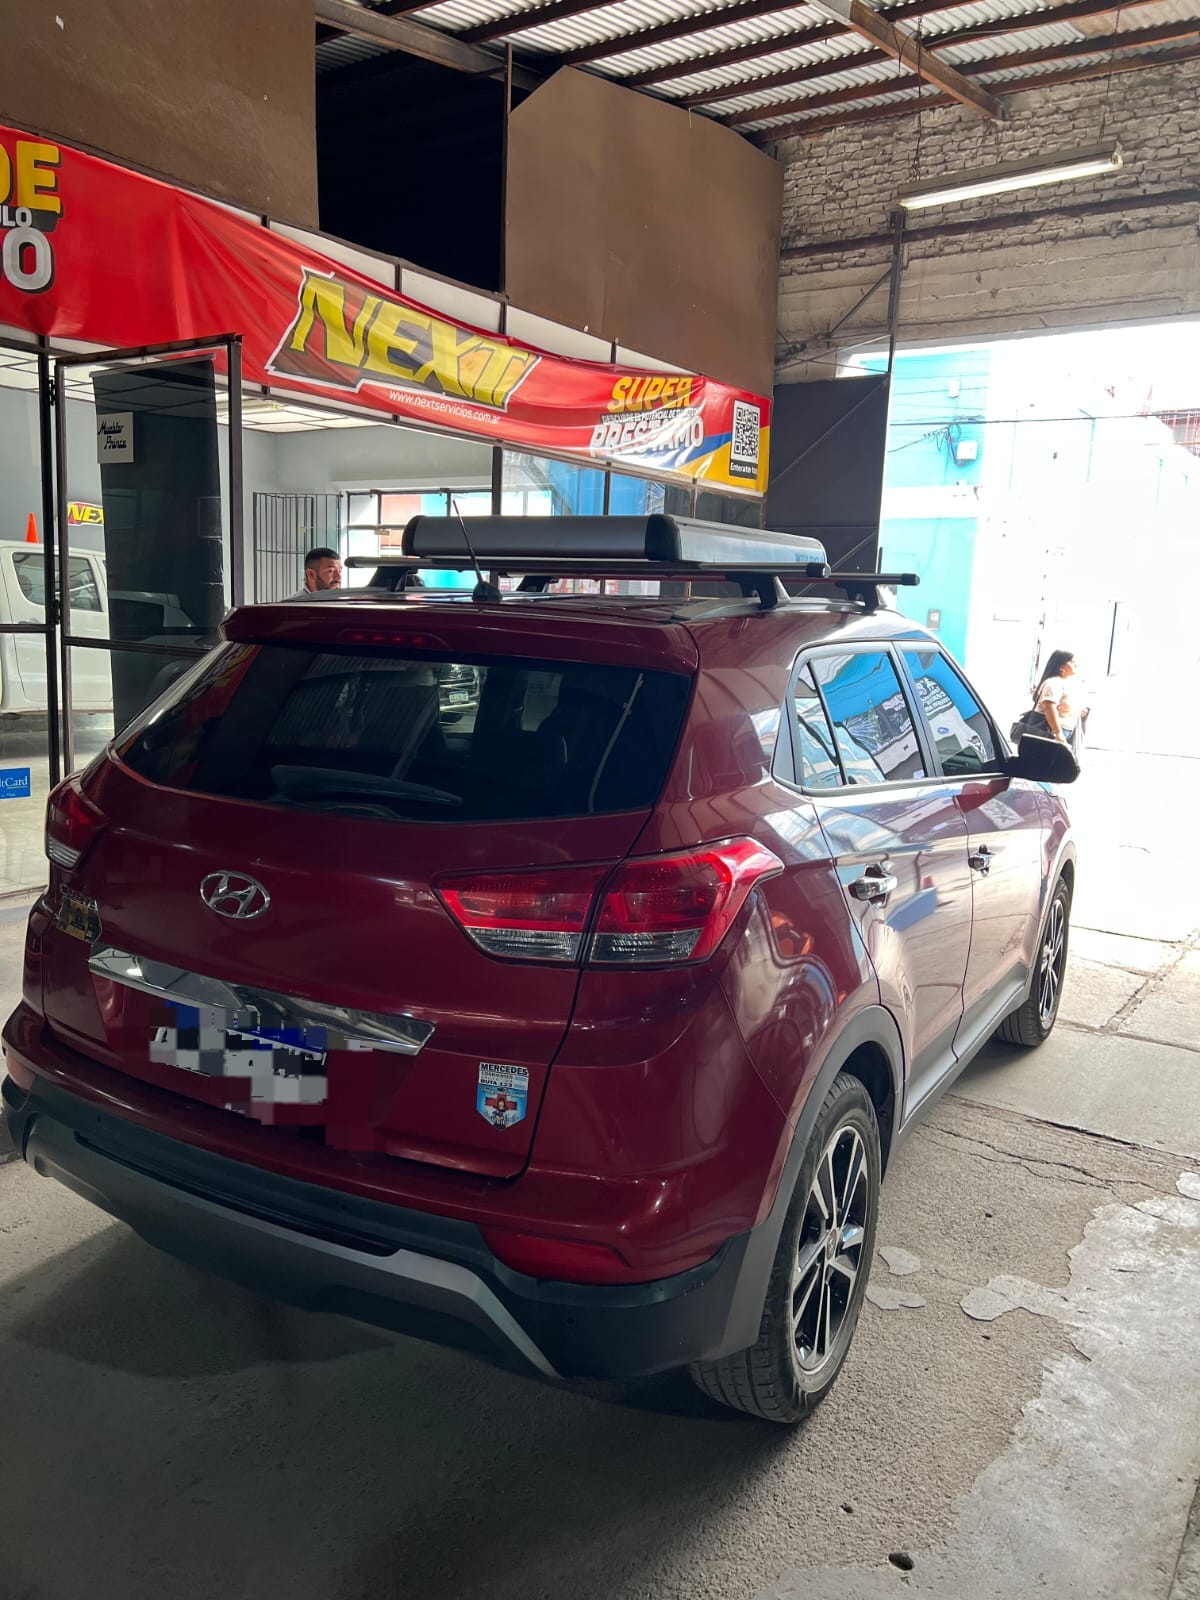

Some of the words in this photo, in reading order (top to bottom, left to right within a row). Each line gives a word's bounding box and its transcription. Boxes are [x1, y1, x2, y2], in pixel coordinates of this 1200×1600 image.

[0, 141, 61, 214] E
[0, 205, 32, 228] LO
[289, 274, 529, 406] NEXT
[389, 390, 500, 424] www.nextservicios.com.ar
[607, 376, 693, 412] SUPER
[480, 1063, 528, 1076] MERCEDES
